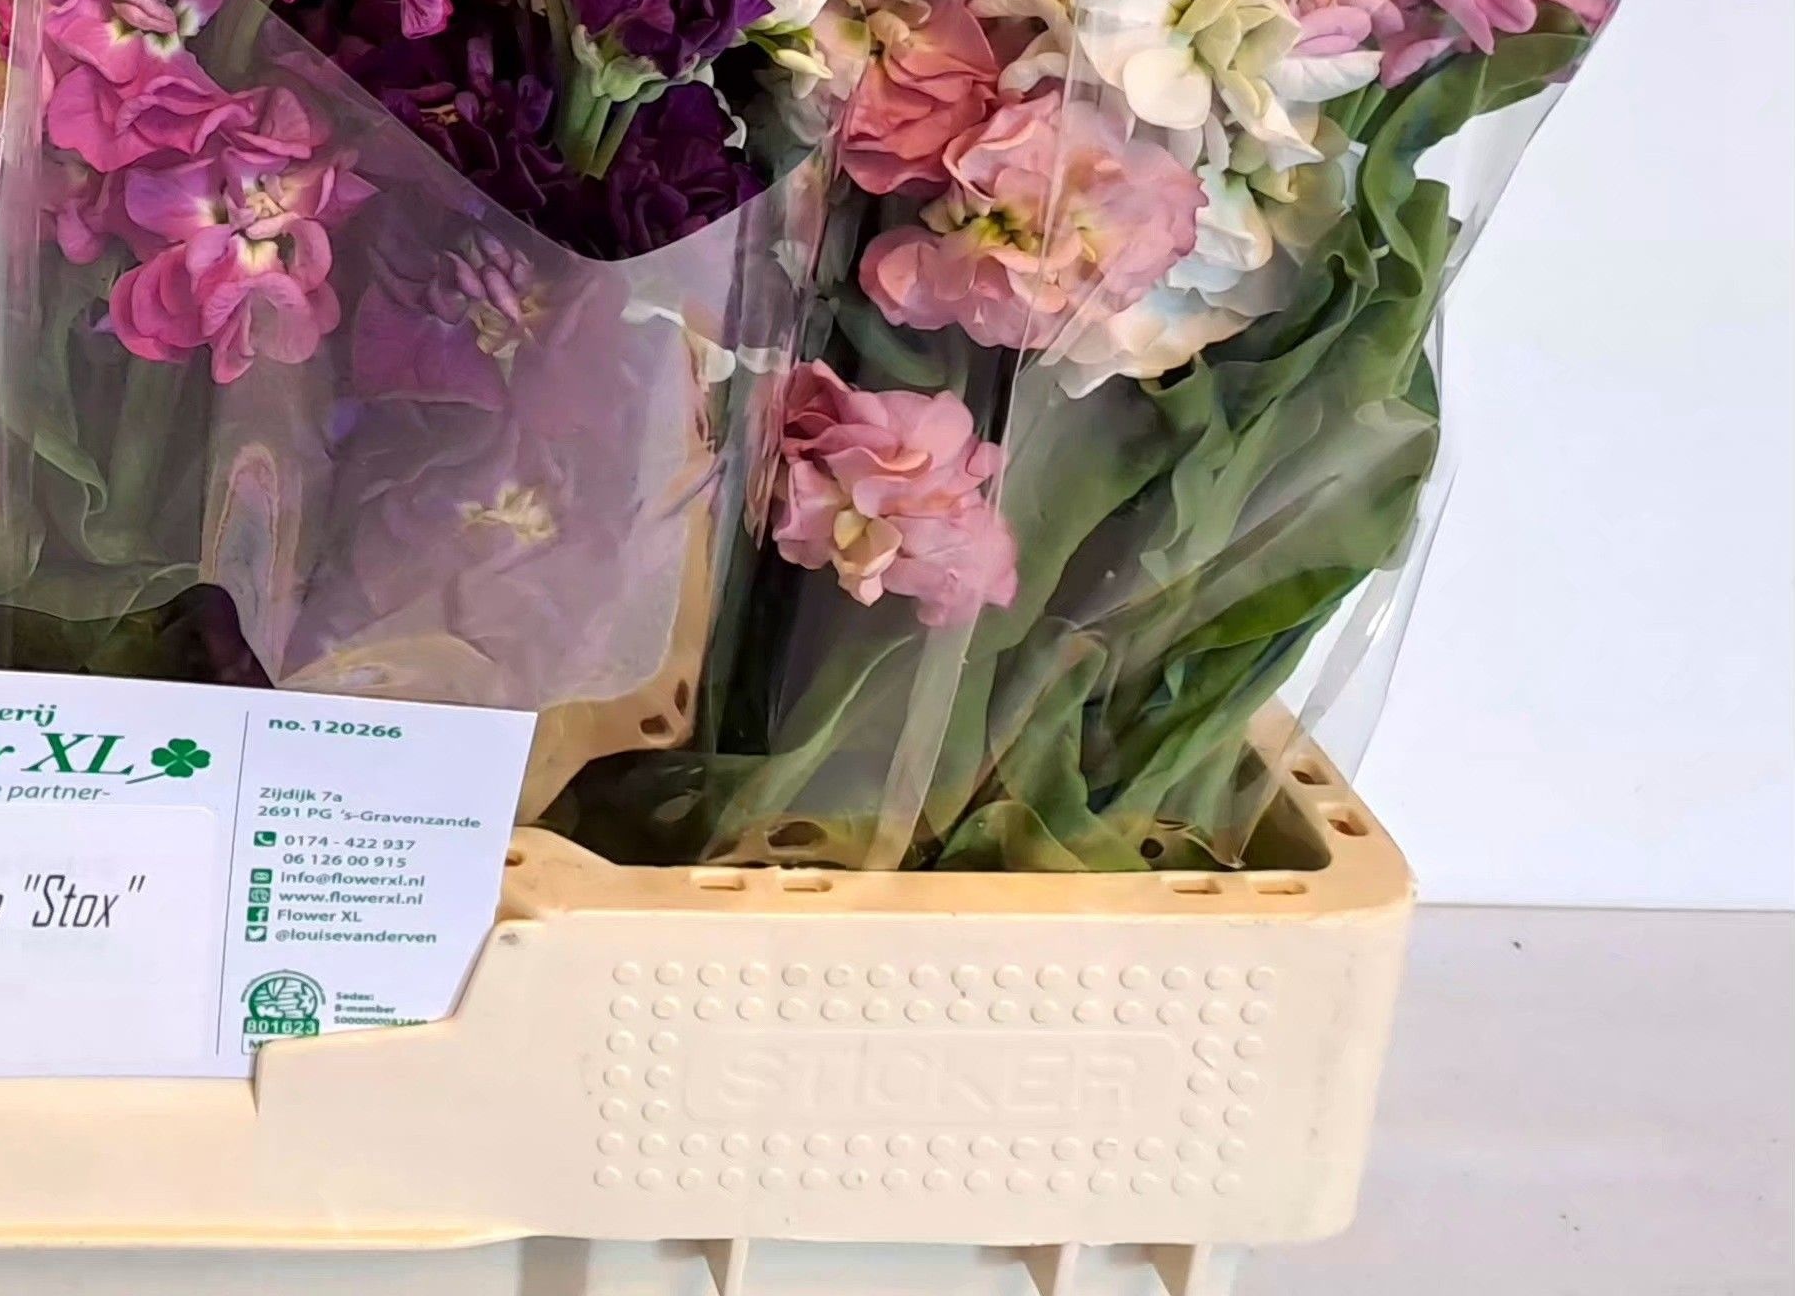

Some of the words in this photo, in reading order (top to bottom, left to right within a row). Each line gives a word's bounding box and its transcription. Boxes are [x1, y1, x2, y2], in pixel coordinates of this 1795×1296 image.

[21, 732, 135, 776] XL
[6, 784, 111, 802] partner-
[259, 786, 317, 804] Zijdijk
[321, 791, 344, 803] 7a
[257, 805, 301, 819] 2691
[307, 807, 333, 820] PG
[284, 835, 329, 847] 0174
[344, 837, 378, 850] 422
[382, 839, 417, 851] 937
[282, 853, 305, 866] 06
[310, 854, 343, 866] 126
[347, 855, 369, 867] 00
[374, 856, 407, 868] 915
[280, 871, 426, 888] info@flowerxl.nl
[278, 891, 424, 906] www.flowerxl.nl
[277, 908, 337, 923] Flower
[340, 910, 363, 923] XL
[275, 928, 438, 944] @louisevanderven
[246, 1019, 318, 1035] 801623
